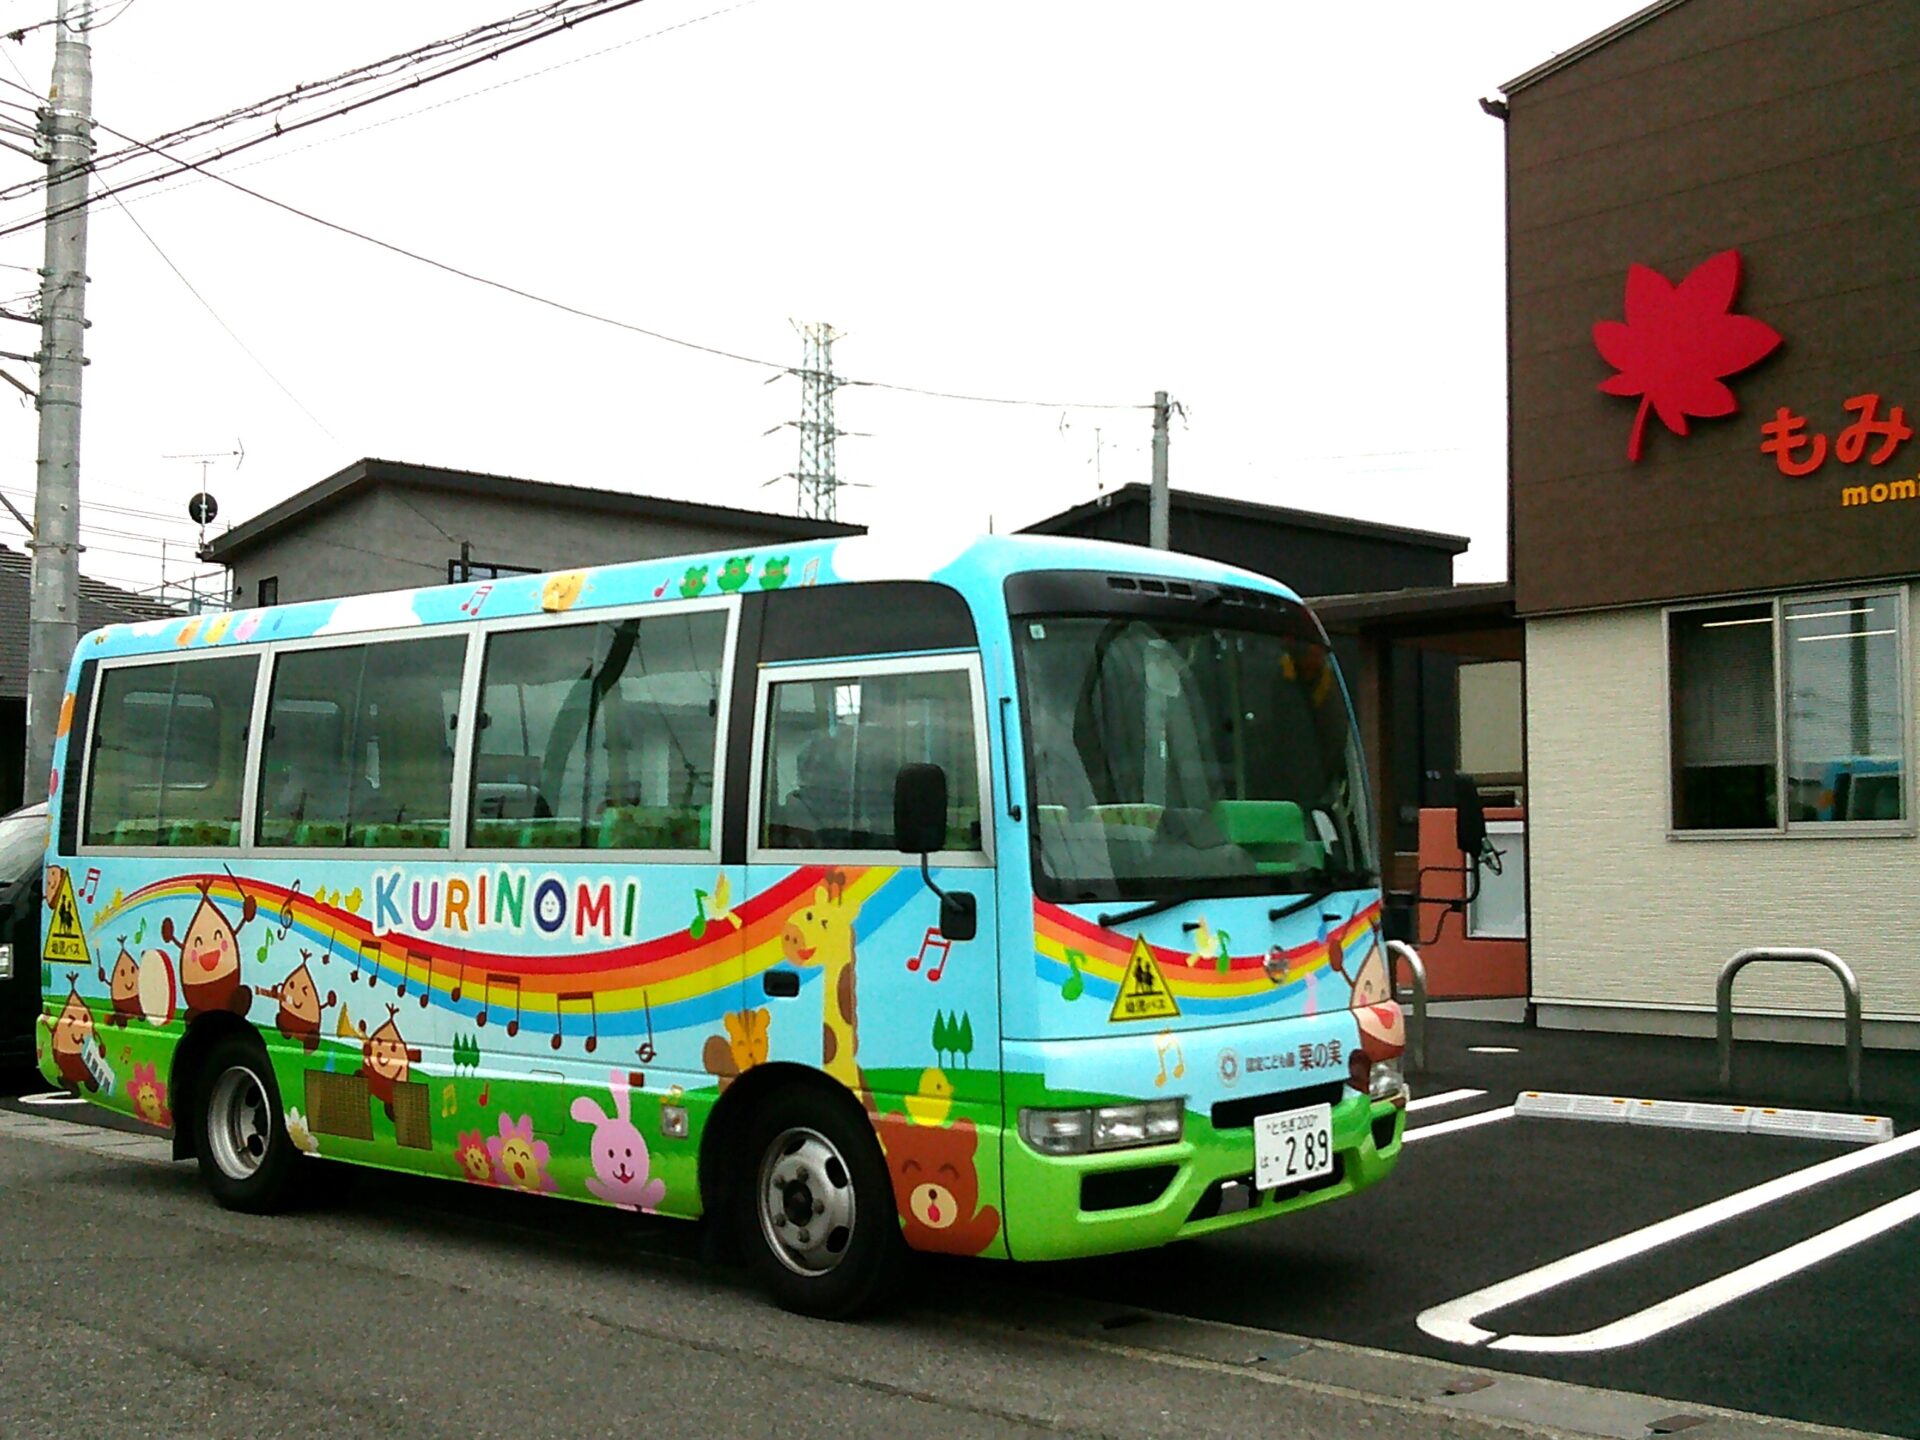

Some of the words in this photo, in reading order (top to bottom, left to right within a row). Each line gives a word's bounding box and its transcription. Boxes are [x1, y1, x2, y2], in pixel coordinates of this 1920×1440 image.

[376, 871, 636, 937] KURINOMI
[1299, 1039, 1342, 1071] 栗の実
